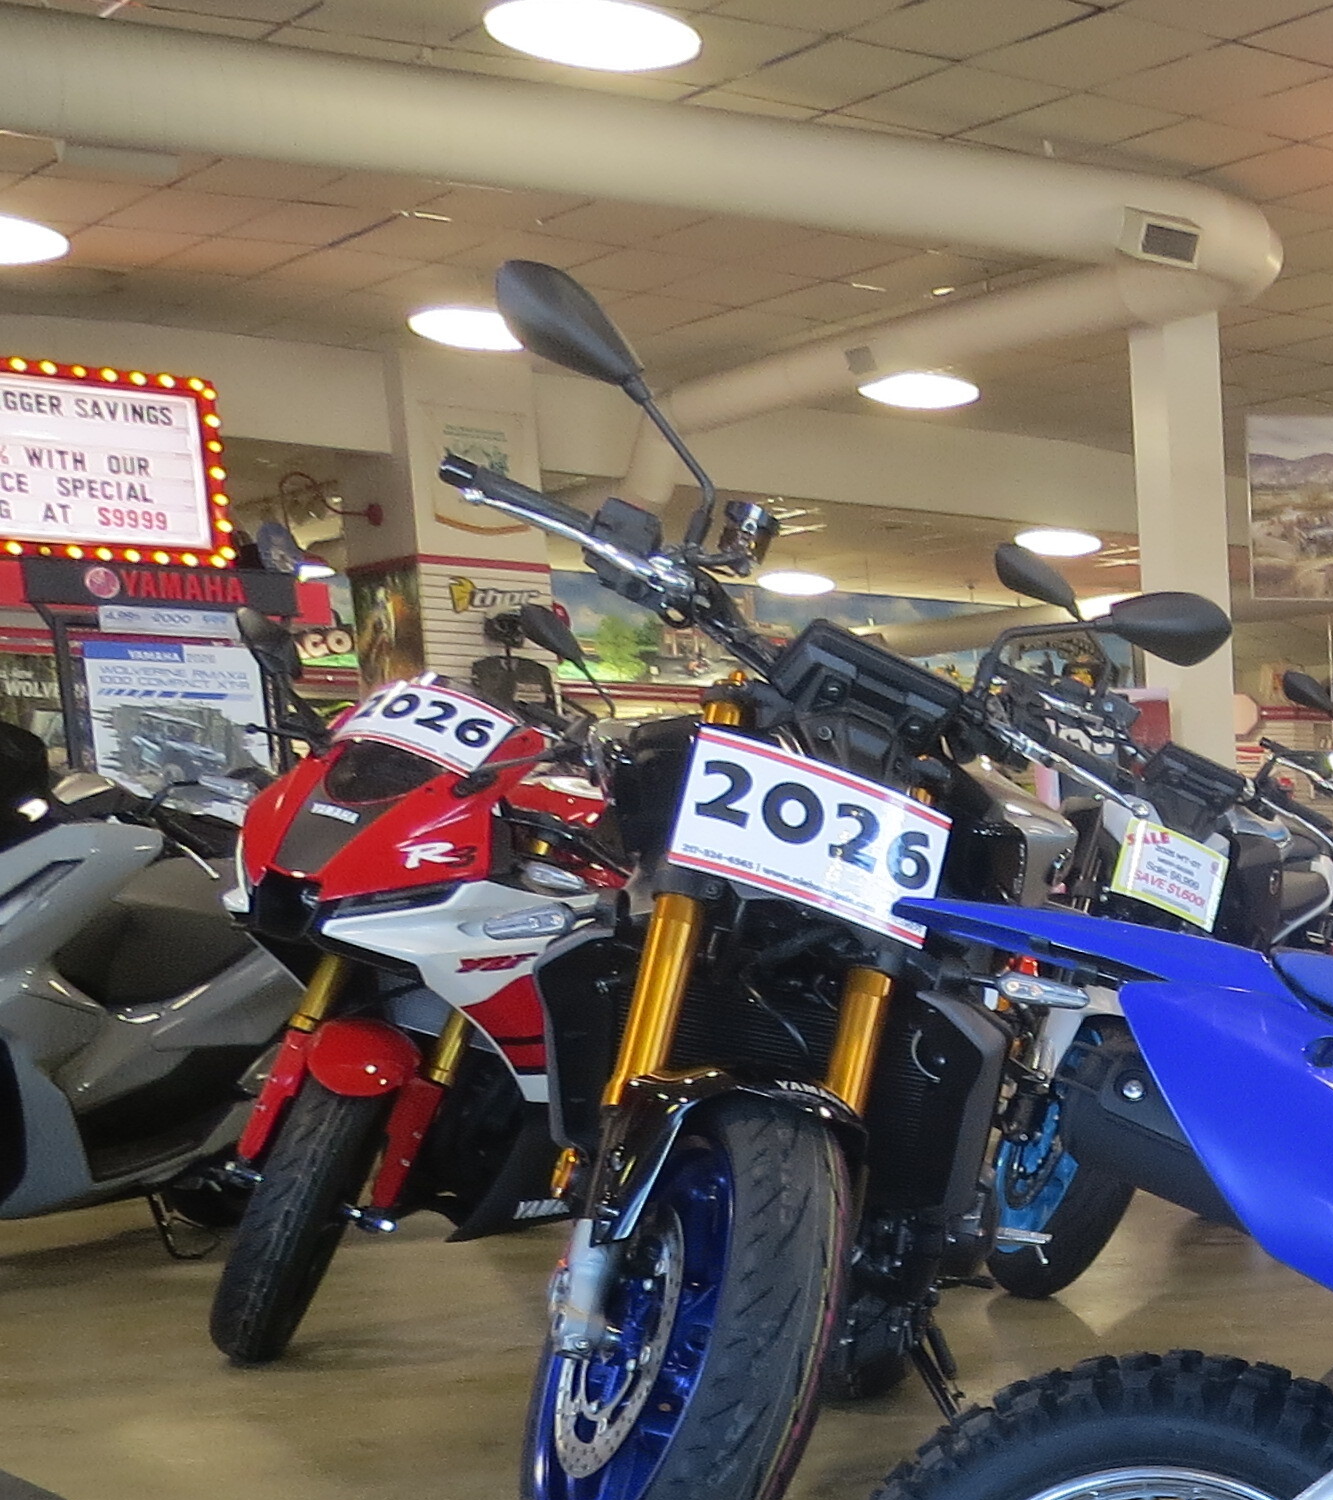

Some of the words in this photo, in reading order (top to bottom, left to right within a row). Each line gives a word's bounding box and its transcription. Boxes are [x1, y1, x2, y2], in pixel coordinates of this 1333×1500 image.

[75, 399, 173, 426] SAVINGS
[24, 446, 87, 472] WITH
[107, 454, 151, 478] OUR
[57, 476, 154, 504] SPECIAL
[43, 503, 72, 524] AT
[120, 569, 247, 604] YAMAHA
[694, 760, 932, 890] 2026
[1135, 870, 1167, 888] SAVE
